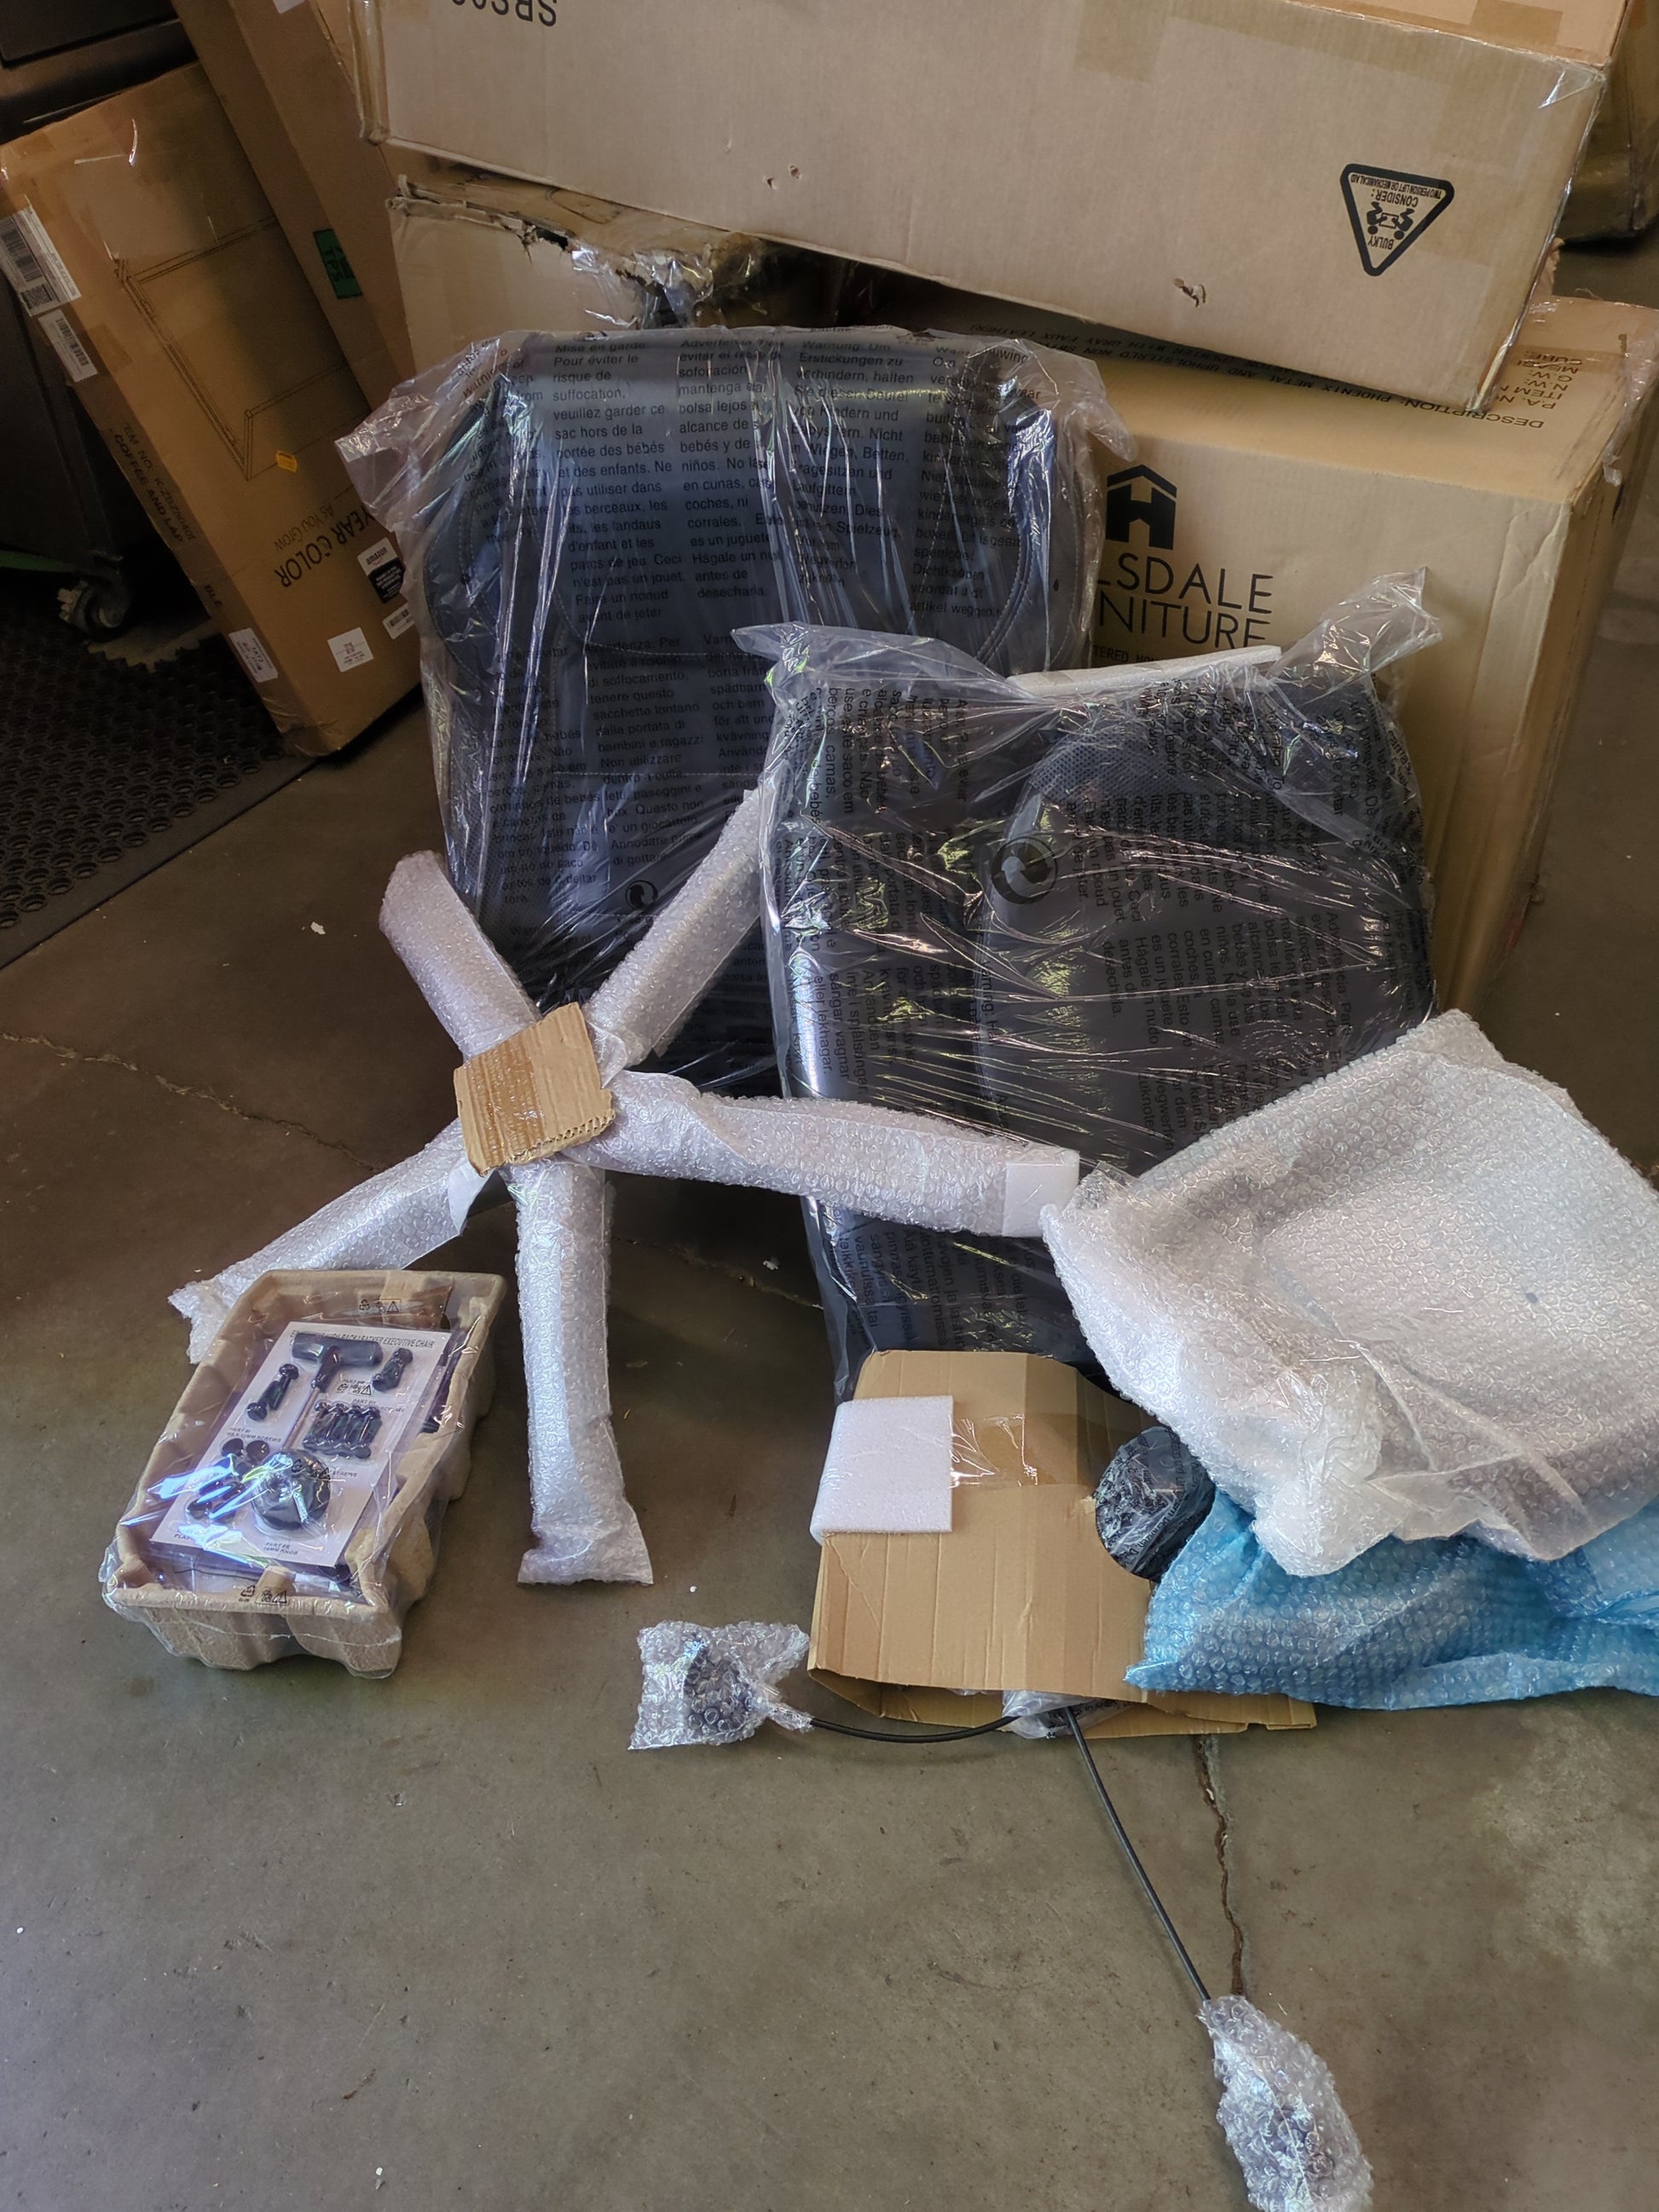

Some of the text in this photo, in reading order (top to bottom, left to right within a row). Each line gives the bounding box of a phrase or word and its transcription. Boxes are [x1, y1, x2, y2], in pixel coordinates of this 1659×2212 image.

[1367, 234, 1395, 251] BULKY
[554, 354, 639, 367] Pour éviter le
[679, 352, 715, 362] evitar
[799, 352, 904, 367] Erstickungen zu
[554, 369, 612, 384] risque de
[873, 370, 914, 384] halten
[1084, 345, 1113, 358] NON
[1118, 351, 1220, 373] UPHOLSTERED
[1227, 367, 1259, 380] AND
[1268, 373, 1315, 389] METAL
[1322, 384, 1392, 403] PHOENIX
[677, 382, 743, 397] mantenga
[1513, 386, 1564, 401] ITEM
[554, 405, 665, 421] veuillez garder ce
[679, 399, 748, 415] bolsa lejos
[873, 407, 899, 423] und
[554, 423, 643, 441] sac hors de la
[679, 418, 750, 435] alcance de
[869, 428, 904, 442] Nicht
[599, 442, 622, 456] des
[626, 441, 666, 455] bébés
[679, 436, 751, 453] bebés y de
[558, 468, 571, 479] et
[573, 465, 597, 477] des
[654, 459, 673, 473] Ne
[725, 456, 745, 470] No
[114, 433, 150, 486] COFFEE
[145, 488, 166, 517] AND
[586, 482, 627, 497] utiliser
[631, 481, 662, 494] dans
[683, 481, 699, 492] en
[649, 500, 668, 512] les
[737, 494, 749, 507] ni
[329, 505, 375, 547] YEAR
[567, 536, 655, 553] d'enfant et les
[690, 533, 724, 548] es un
[273, 534, 333, 588] COLOR
[653, 552, 682, 566] Ceci
[691, 550, 757, 566] Hágale un
[606, 575, 628, 590] pas
[632, 572, 648, 585] un
[695, 568, 749, 582] antes de
[615, 609, 632, 622] de
[708, 666, 739, 679] borta
[590, 688, 674, 706] tenere questo
[712, 696, 766, 712] och barn
[592, 702, 700, 721] sacchetto lontano
[627, 719, 685, 736] portata di
[597, 736, 646, 753] bambini
[649, 740, 657, 749] e
[842, 687, 855, 814] use saco em
[599, 756, 627, 769] Non
[1165, 734, 1179, 777] before
[858, 771, 872, 800] Não
[634, 800, 705, 819] Questo non
[810, 781, 824, 824] bebés
[1128, 889, 1142, 922] Ceci
[1176, 886, 1189, 908] les
[1231, 923, 1249, 965] bebés
[1263, 919, 1279, 958] bolsa
[1118, 939, 1132, 979] antes
[1150, 934, 1165, 974] es un
[812, 975, 829, 1005] eller
[1176, 995, 1191, 1026] Esto
[1146, 1008, 1160, 1045] nudo
[1227, 1011, 1240, 1037] use
[834, 1031, 851, 1079] vagnar
[1174, 1096, 1188, 1129] dem
[383, 1337, 417, 1349] EXECUTIVE
[415, 1338, 436, 1349] CHAIR
